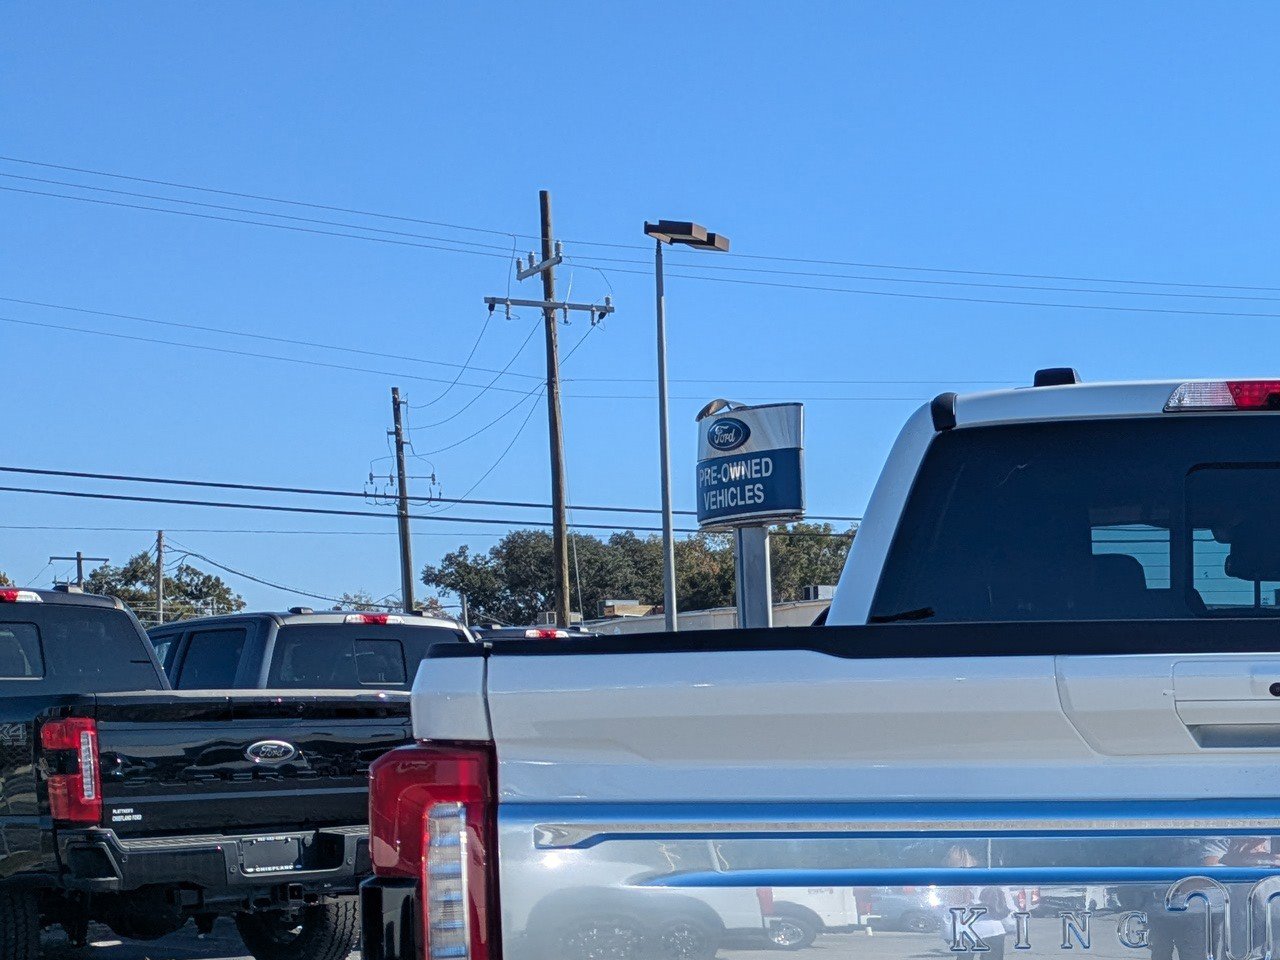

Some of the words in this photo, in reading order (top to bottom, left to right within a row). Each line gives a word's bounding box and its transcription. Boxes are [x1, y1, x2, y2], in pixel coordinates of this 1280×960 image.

[713, 425, 736, 444] Ford
[699, 457, 773, 488] PRE-OWNED
[703, 483, 765, 511] VEHICLES
[258, 744, 285, 758] Ford
[949, 906, 1149, 953] KING
